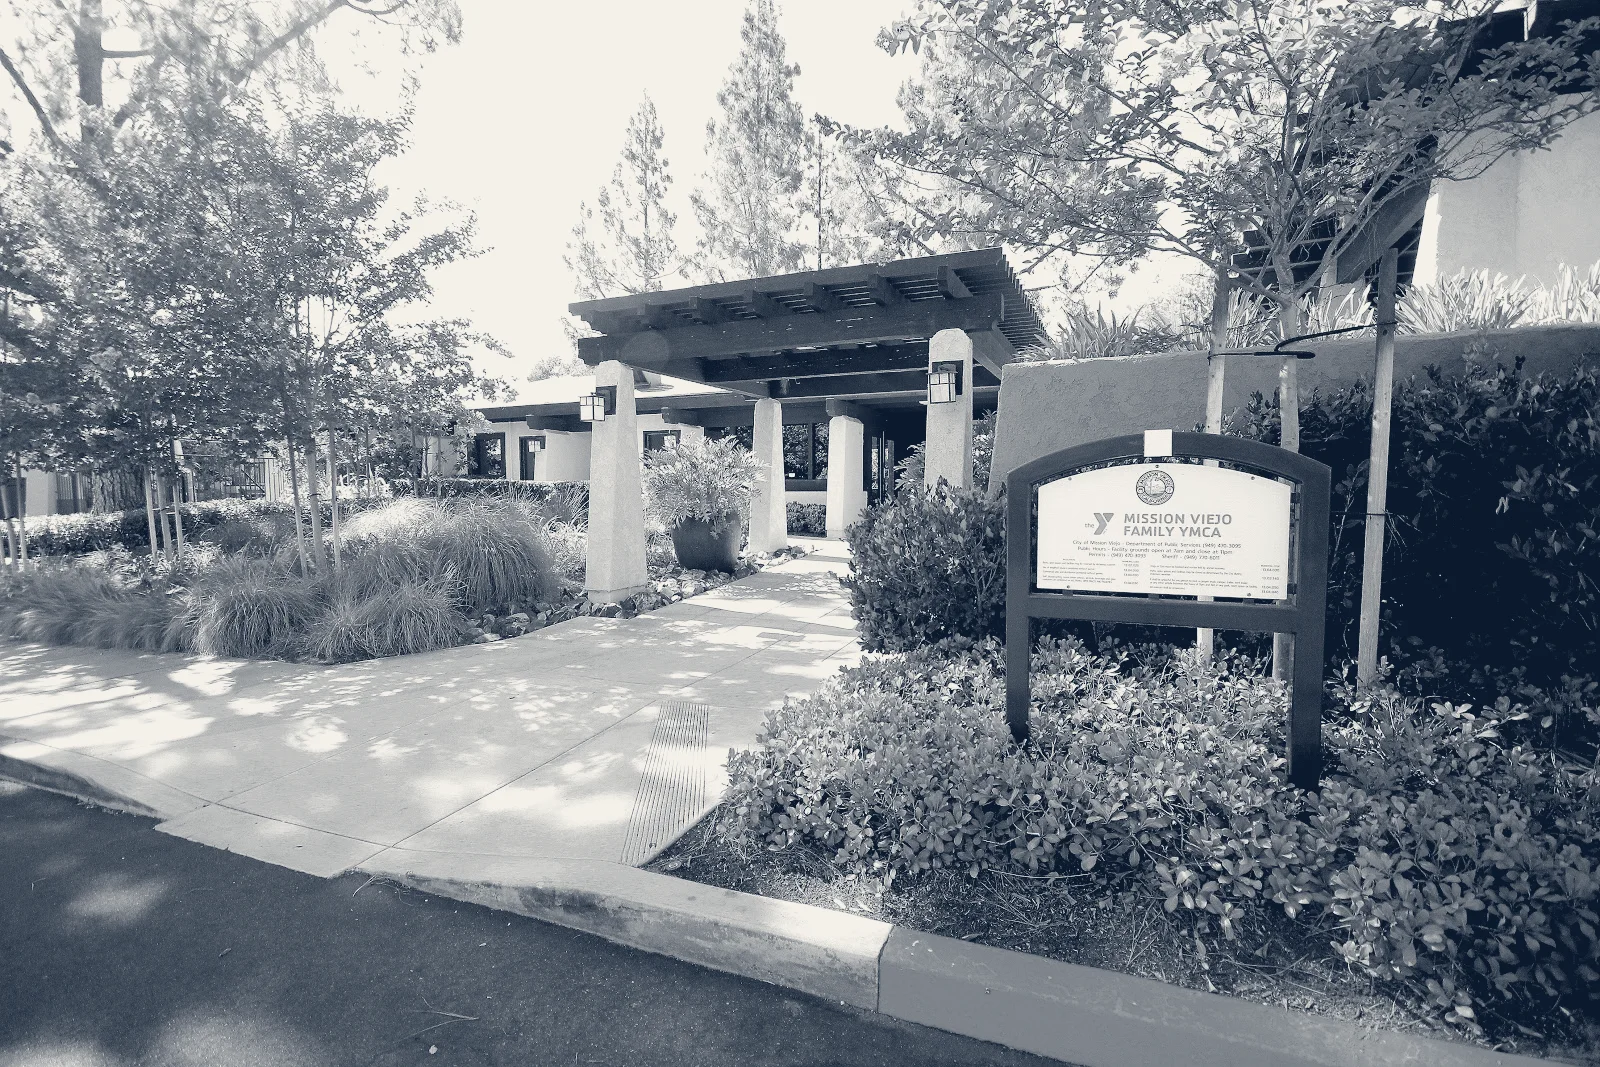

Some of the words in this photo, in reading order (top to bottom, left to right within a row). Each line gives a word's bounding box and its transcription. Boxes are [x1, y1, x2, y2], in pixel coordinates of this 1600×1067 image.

[1124, 514, 1185, 524] MISSION
[1190, 514, 1232, 525] VIEJO
[1124, 526, 1175, 537] FAMILY
[1179, 526, 1222, 538] YMCA
